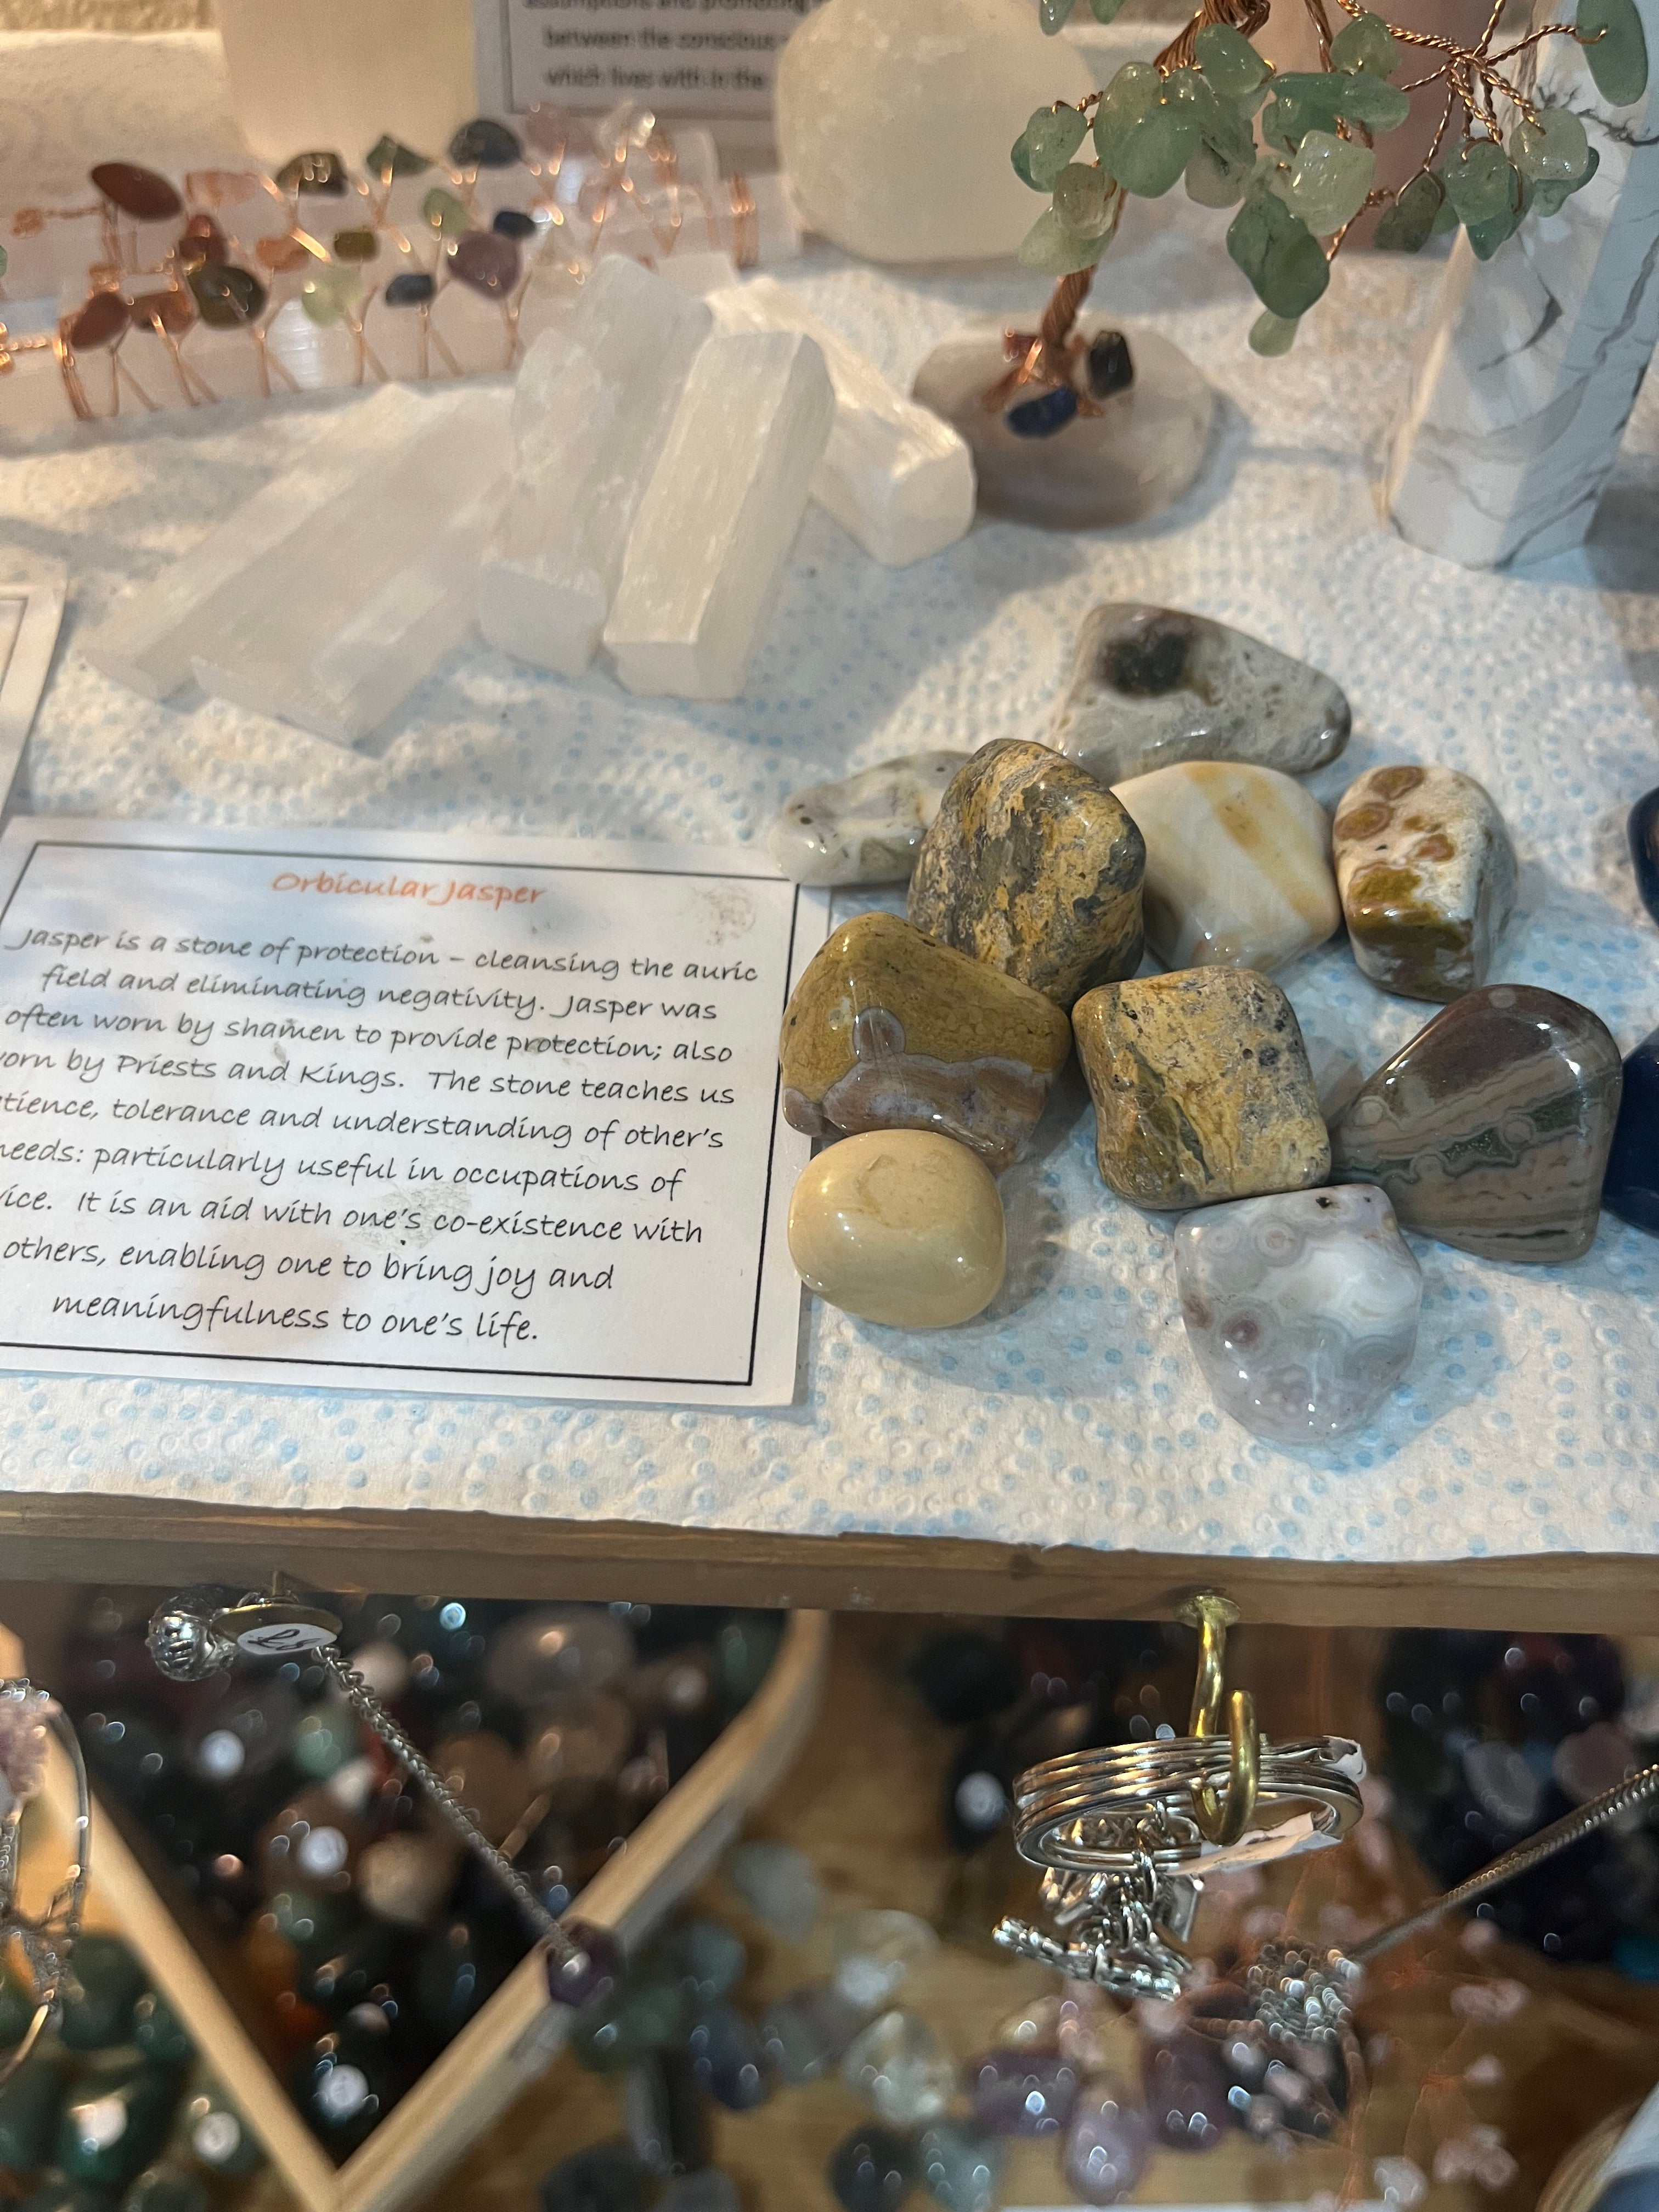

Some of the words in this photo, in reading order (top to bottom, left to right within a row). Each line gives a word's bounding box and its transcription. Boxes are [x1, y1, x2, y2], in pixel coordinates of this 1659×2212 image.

[273, 872, 436, 898] Orbicular
[427, 882, 544, 910] Jasper
[4, 929, 108, 955] Jasper
[115, 930, 140, 950] is
[149, 936, 167, 951] a
[175, 936, 252, 957] stone
[259, 936, 295, 964] of
[296, 942, 439, 967] protection
[475, 950, 619, 981] cleansing
[630, 957, 673, 978] the
[683, 961, 758, 981] auric
[43, 964, 111, 991] field
[119, 973, 179, 991] and
[186, 974, 365, 1008] eliminating
[379, 987, 544, 1020] negativity.
[549, 995, 653, 1023] Jasper
[661, 1002, 716, 1019] was
[5, 1003, 83, 1032] often
[94, 1014, 167, 1031] worn
[176, 1012, 215, 1046] by
[224, 1017, 345, 1041] shamen
[356, 1024, 381, 1044] to
[391, 1027, 497, 1053] provide
[506, 1035, 662, 1060] protection;
[673, 1040, 732, 1063] also
[66, 1048, 105, 1083] by
[117, 1053, 217, 1078] Priests
[228, 1057, 287, 1082] and
[300, 1063, 404, 1094] Kings.
[428, 1069, 481, 1092] The
[490, 1074, 571, 1096] stone
[581, 1079, 689, 1102] teaches
[701, 1088, 734, 1104] us
[112, 1099, 250, 1126] tolerance
[259, 1106, 323, 1128] and
[332, 1110, 572, 1148] understanding
[584, 1119, 620, 1151] of
[625, 1124, 723, 1148] other's
[92, 1144, 285, 1186] particularly
[297, 1153, 397, 1186] useful
[408, 1158, 443, 1181] in
[453, 1165, 639, 1197] occupations
[651, 1168, 686, 1201] of
[77, 1192, 101, 1212] It
[109, 1190, 136, 1215] is
[148, 1198, 191, 1216] an
[200, 1196, 253, 1221] aid
[264, 1199, 331, 1225] with
[343, 1206, 421, 1230] one's
[434, 1210, 622, 1240] co-existence
[634, 1217, 702, 1243] with
[3, 1235, 105, 1267] others,
[120, 1242, 264, 1281] enabling
[277, 1257, 332, 1277] one
[342, 1255, 371, 1278] to
[383, 1252, 473, 1291] bring
[475, 1255, 535, 1300] joy
[549, 1264, 614, 1289] and
[52, 1293, 329, 1332] meaningfulness
[342, 1307, 371, 1331] to
[381, 1312, 462, 1336] one's
[476, 1311, 537, 1348] life.
